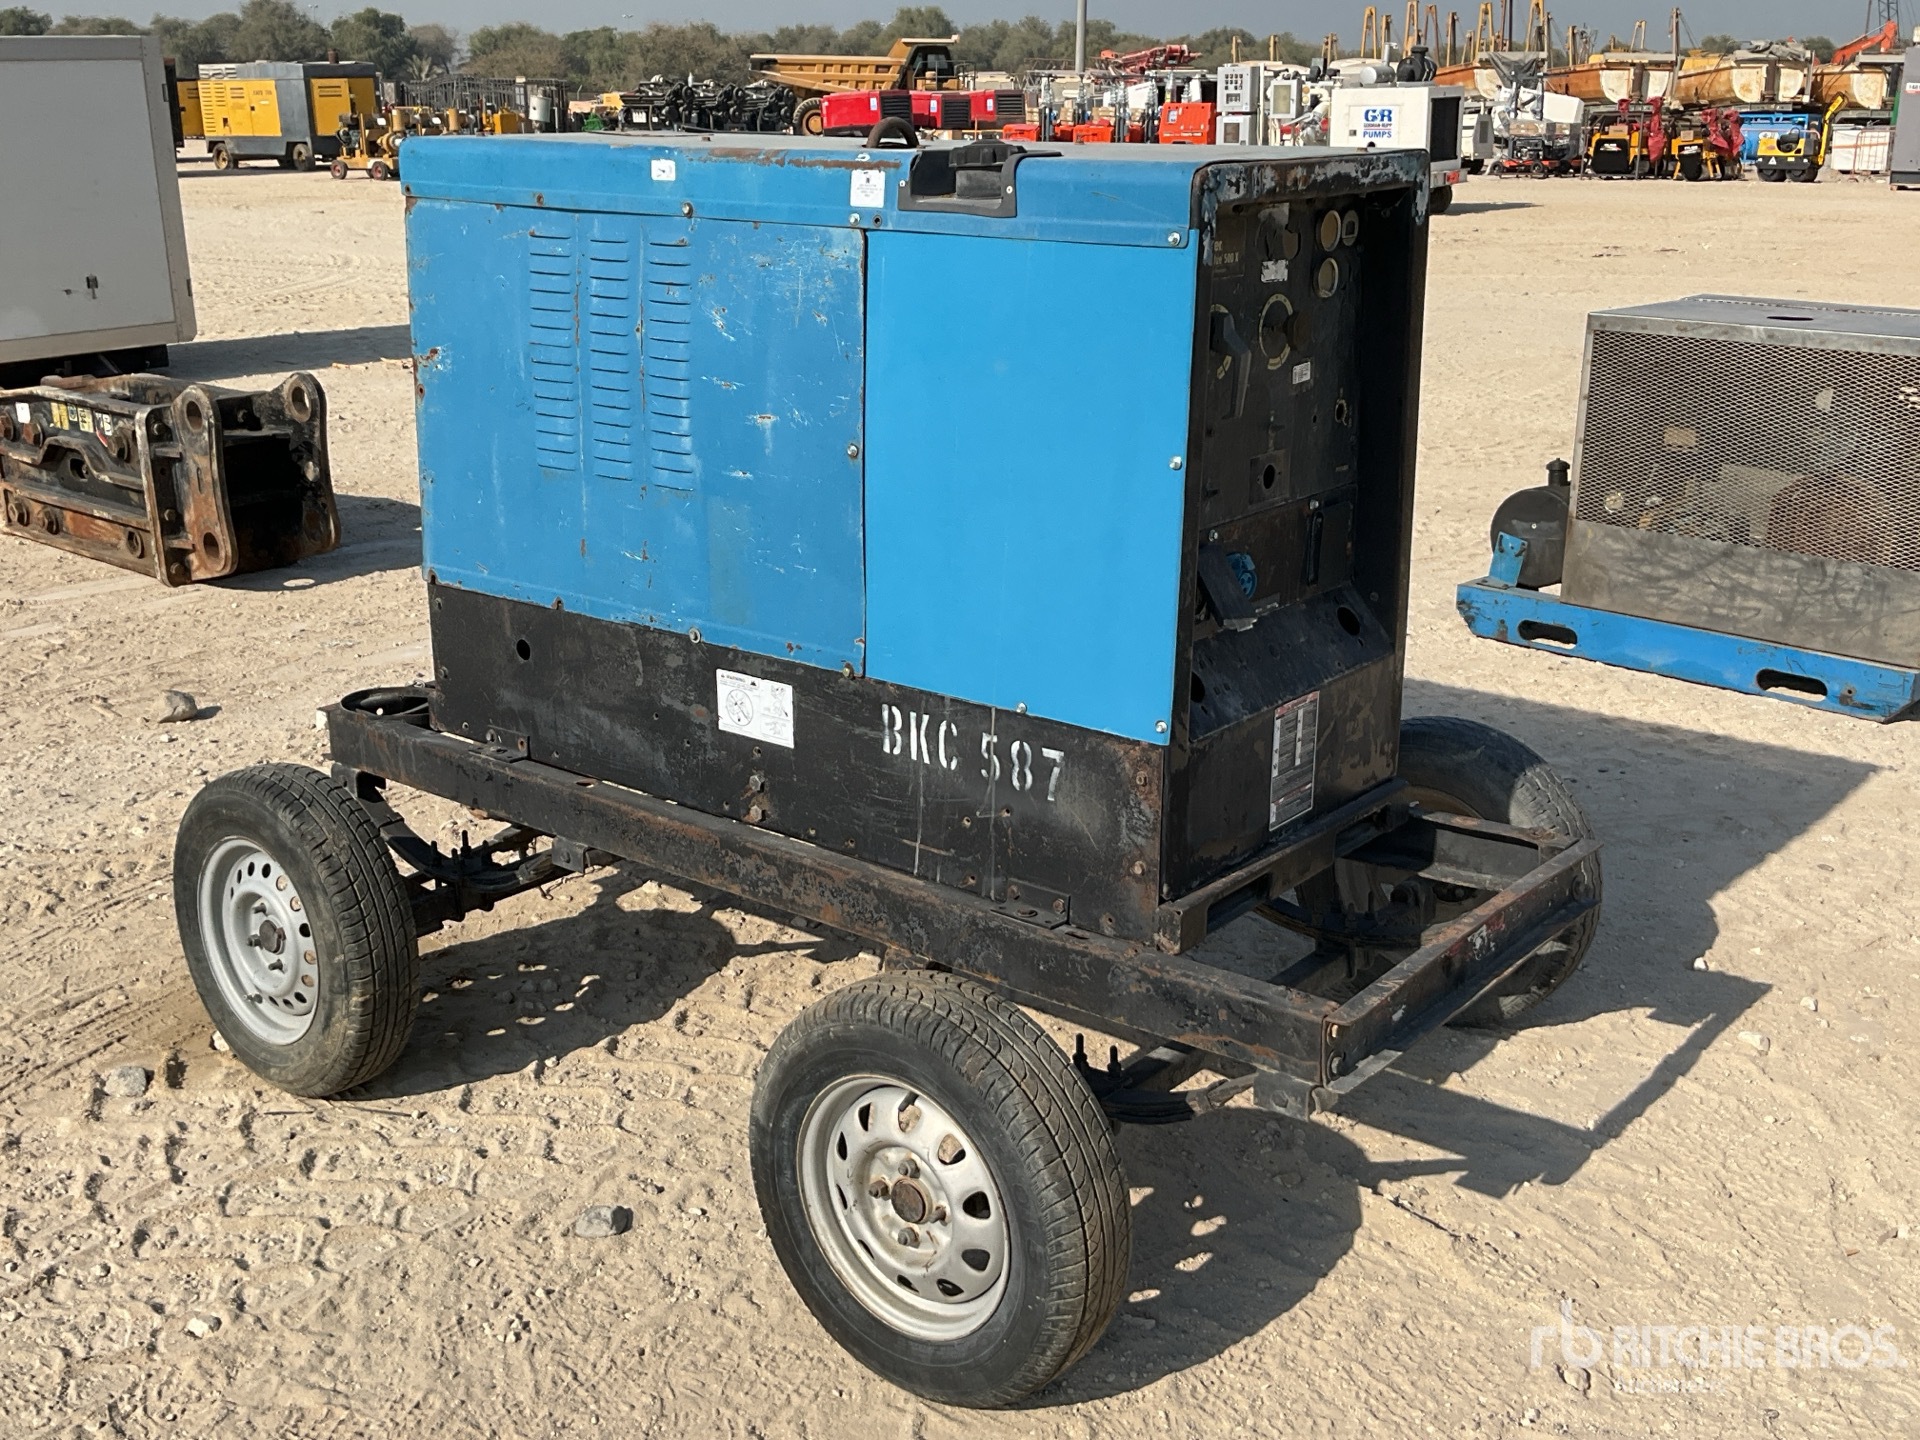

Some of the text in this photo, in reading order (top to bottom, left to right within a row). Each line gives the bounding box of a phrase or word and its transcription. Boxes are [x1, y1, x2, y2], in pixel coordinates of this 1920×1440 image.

[1363, 131, 1392, 139] PUMPS
[880, 702, 1065, 802] BKC 587
